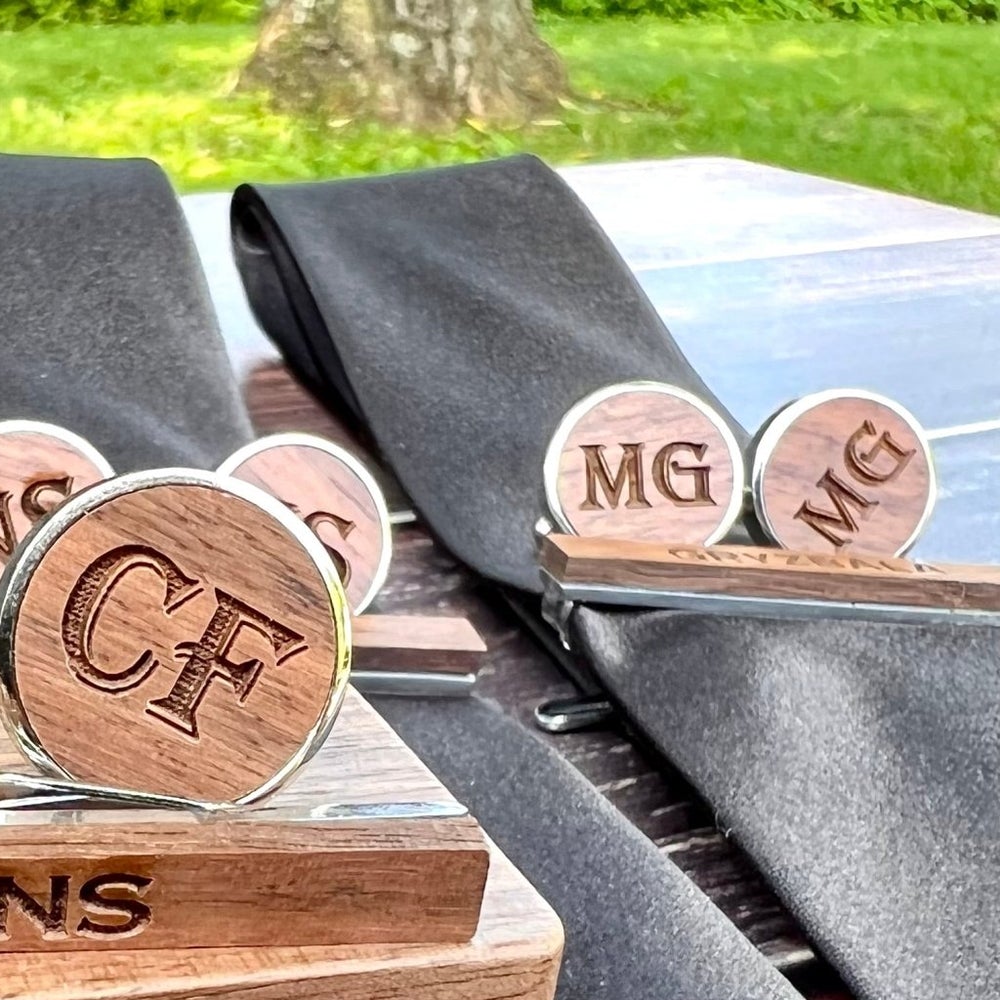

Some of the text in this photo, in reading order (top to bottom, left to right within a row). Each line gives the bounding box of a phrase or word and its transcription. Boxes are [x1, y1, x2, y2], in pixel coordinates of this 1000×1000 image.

[578, 440, 717, 511] MG
[794, 418, 917, 548] MG
[61, 543, 309, 740] CF
